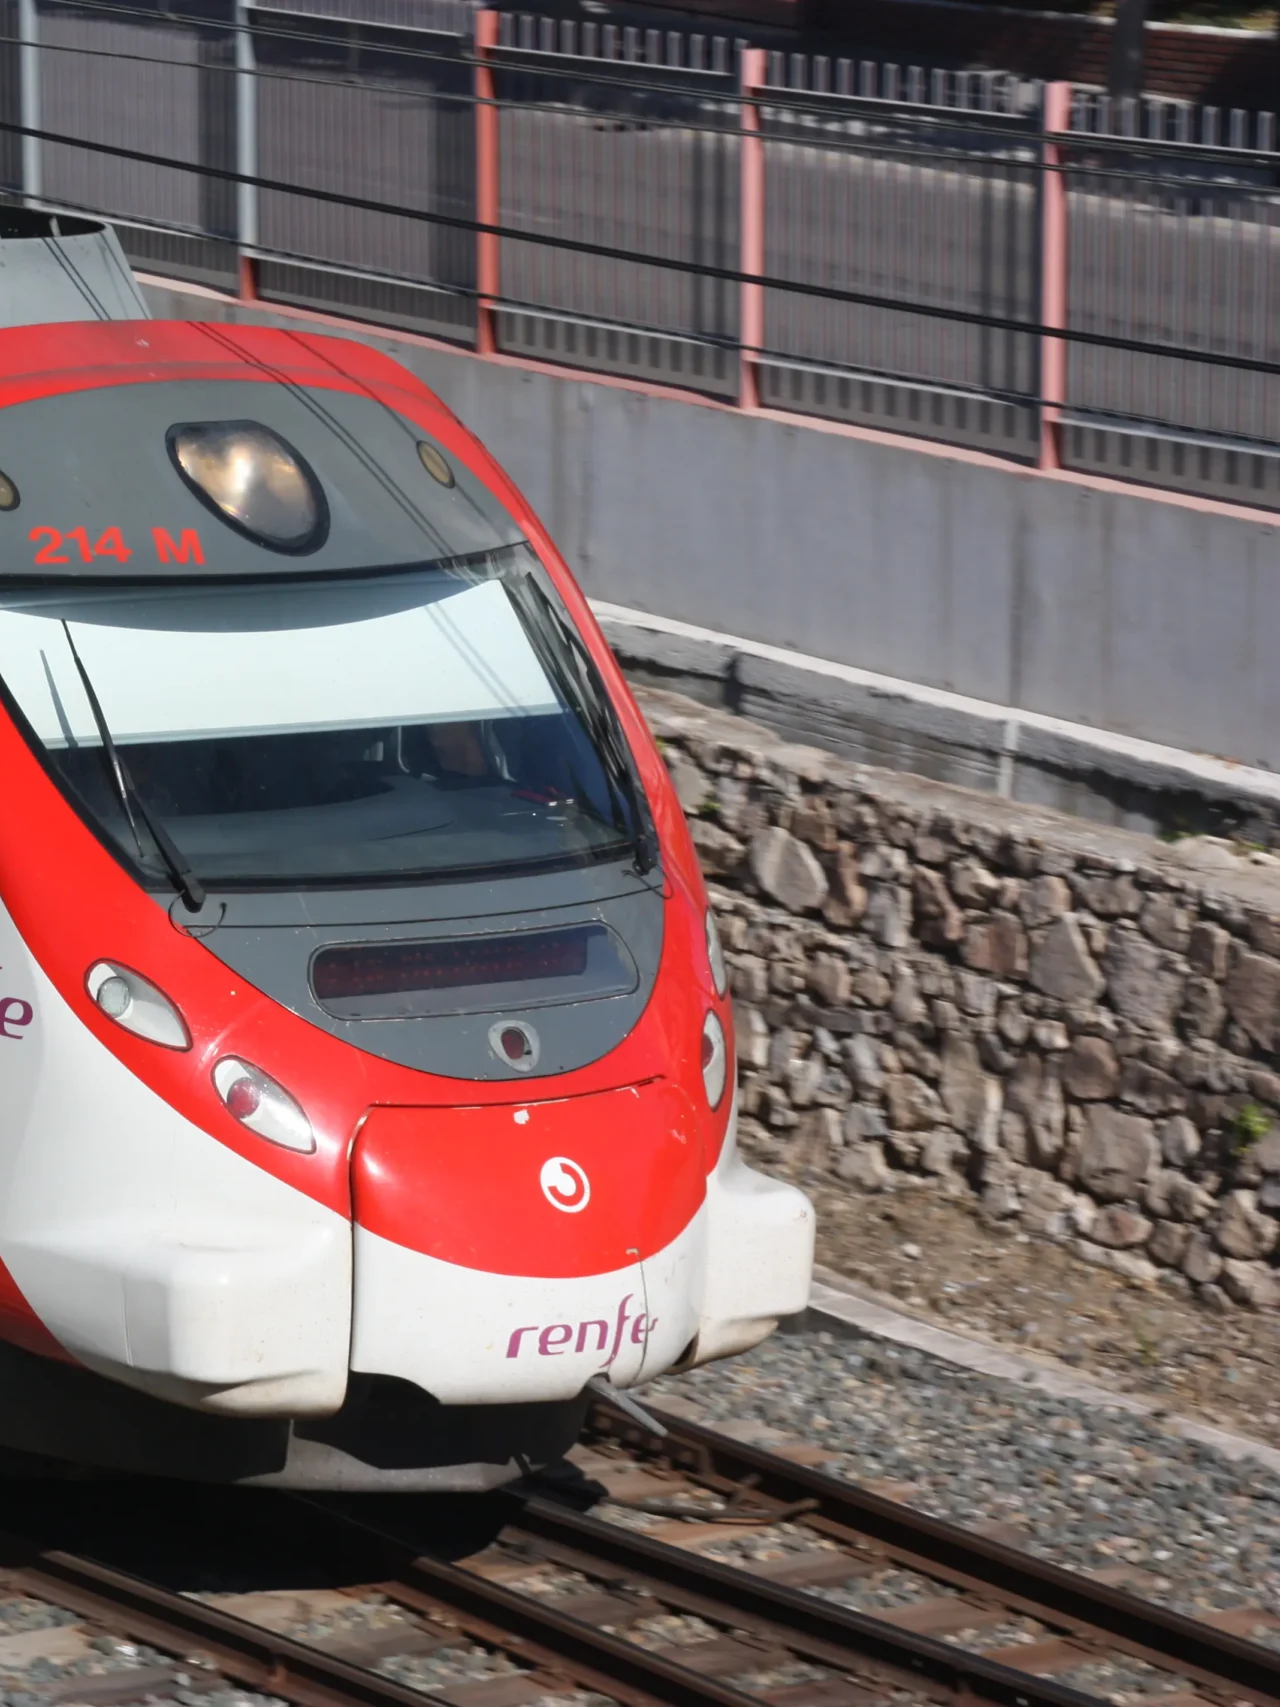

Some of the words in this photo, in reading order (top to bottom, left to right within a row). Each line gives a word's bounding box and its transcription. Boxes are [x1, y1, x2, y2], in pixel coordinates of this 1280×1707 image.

[27, 525, 133, 565] 214
[150, 526, 206, 565] M
[506, 1294, 658, 1368] renfe
